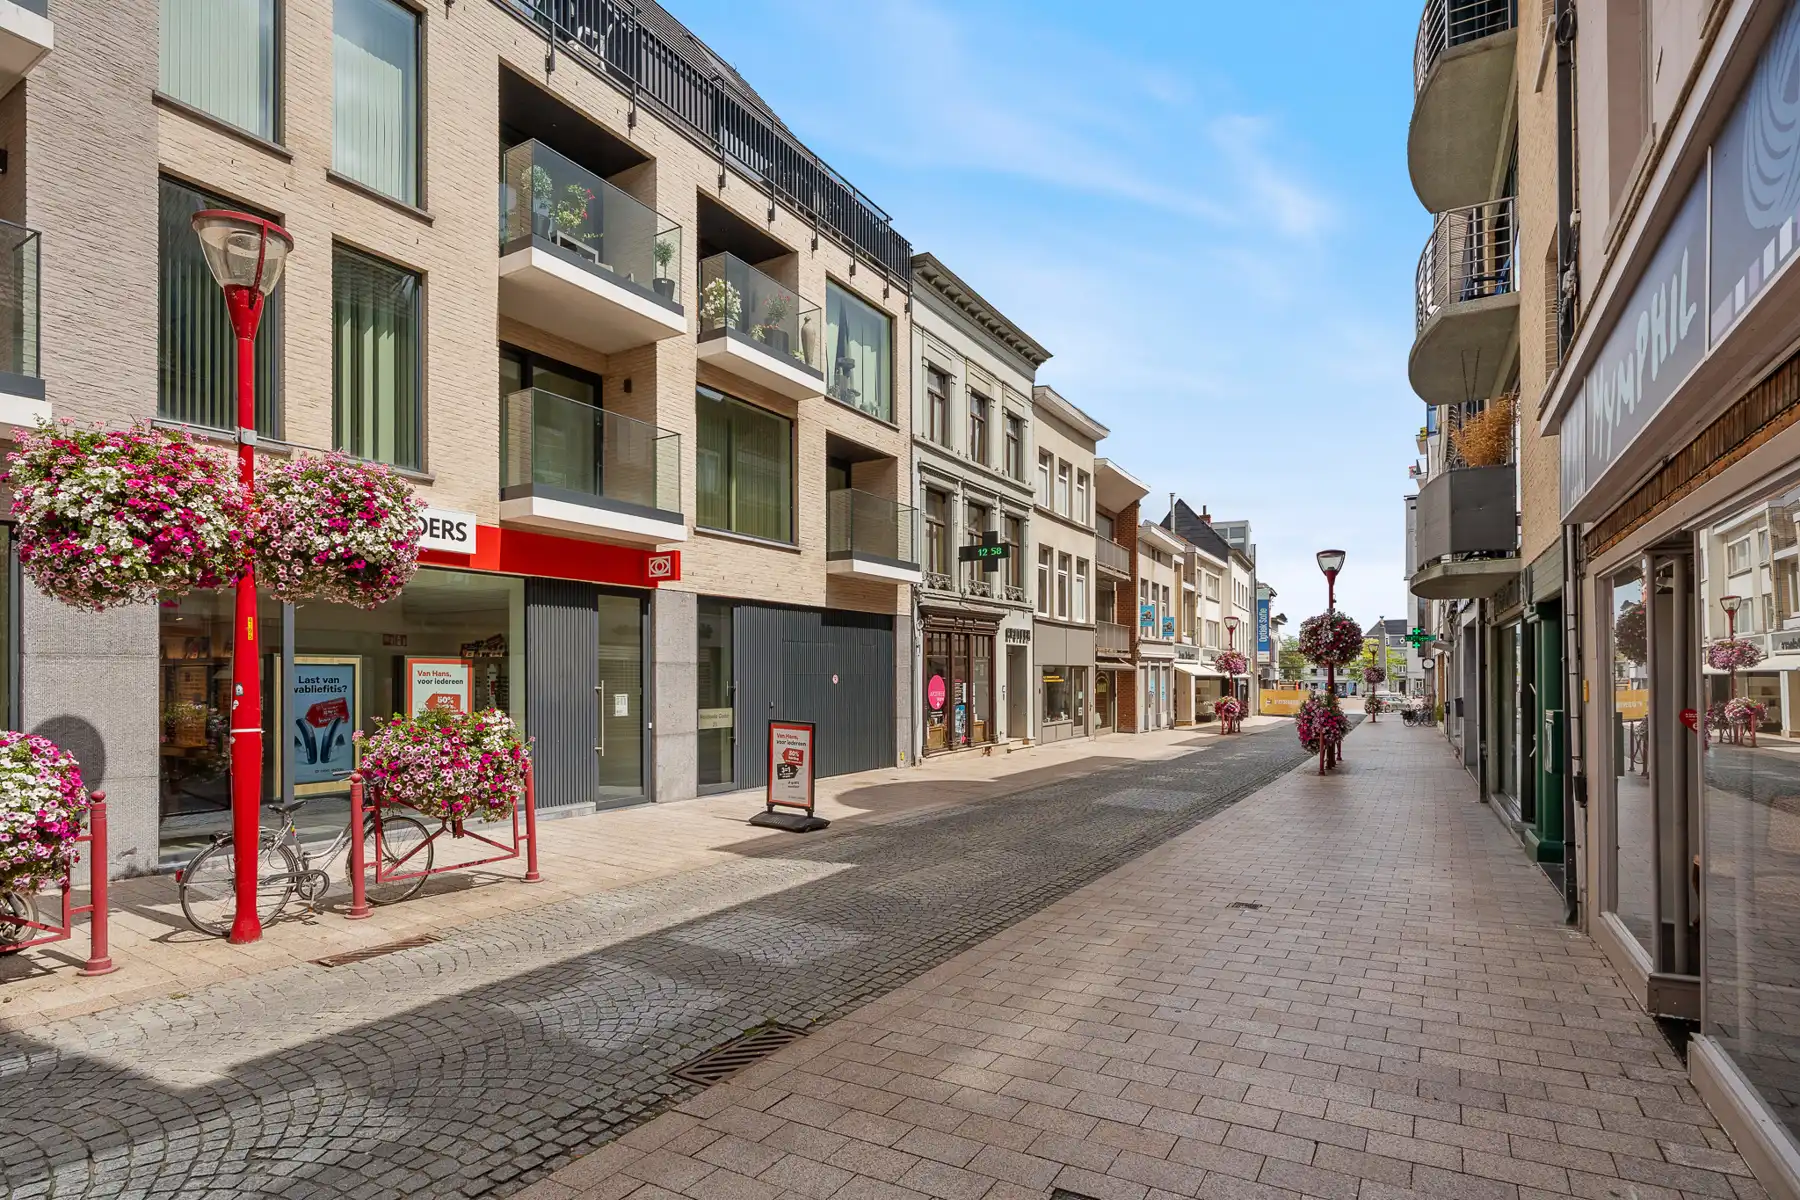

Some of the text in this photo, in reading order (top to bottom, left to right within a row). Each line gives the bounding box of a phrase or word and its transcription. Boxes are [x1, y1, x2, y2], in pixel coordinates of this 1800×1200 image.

[977, 547, 1002, 557] 12 58
[432, 670, 452, 678] Hans,
[298, 675, 320, 684] Last
